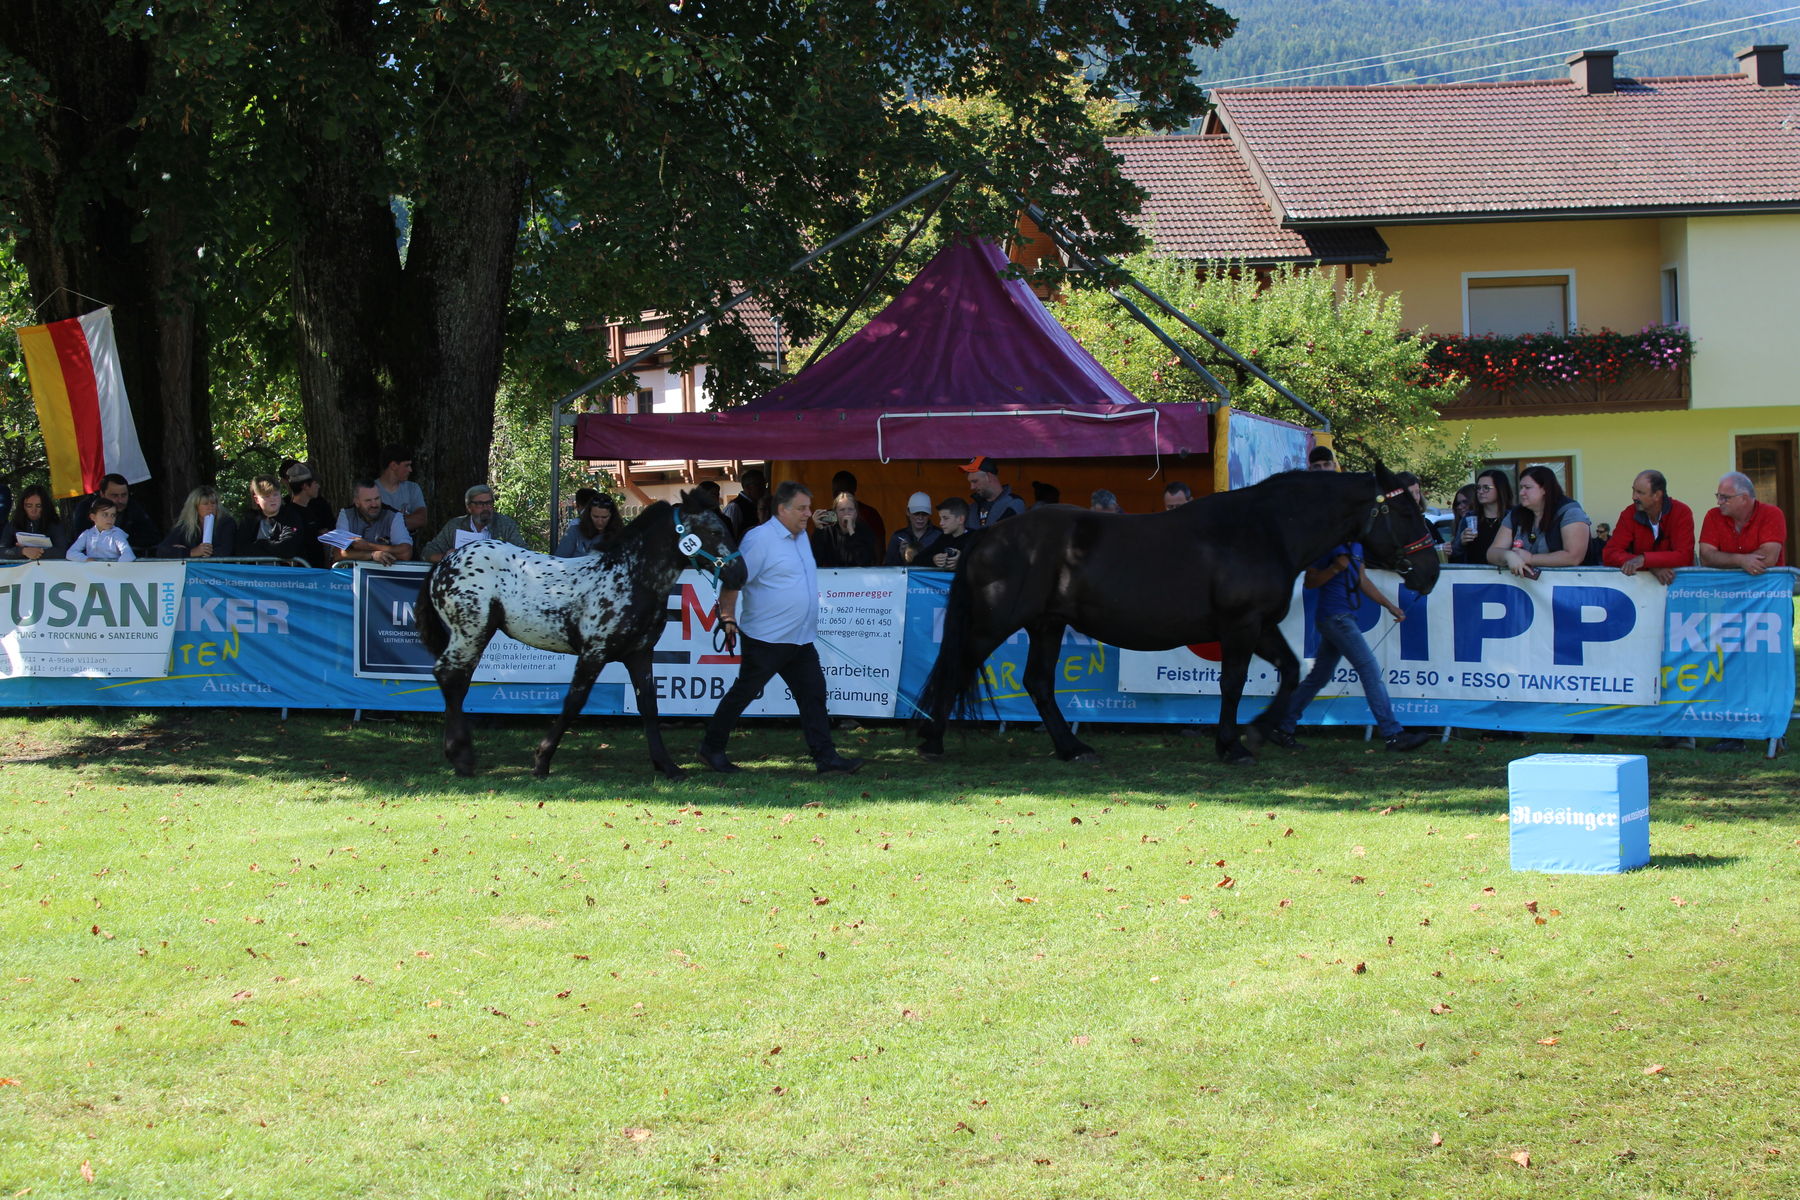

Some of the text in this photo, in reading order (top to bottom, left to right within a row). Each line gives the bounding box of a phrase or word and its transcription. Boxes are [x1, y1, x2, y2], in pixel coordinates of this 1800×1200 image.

[683, 537, 698, 552] 64
[186, 577, 318, 589] .pferde-kaerntenaustria.at
[826, 590, 893, 599] Sommeregger
[162, 582, 175, 627] GmbH
[837, 606, 854, 614] 9620
[855, 607, 892, 616] Hermagor
[829, 617, 847, 625] 0650
[855, 618, 865, 626] 60
[867, 618, 875, 626] 61
[878, 618, 892, 626] 450
[49, 631, 97, 640] TROCKNUNG
[108, 632, 159, 640] SANIERUNG
[817, 630, 891, 639] mmeregger@gmx.at
[503, 643, 519, 651] 676
[78, 656, 107, 664] Villach
[820, 663, 889, 678] erarbeiten
[202, 679, 272, 693] Austria
[1389, 671, 1410, 684] 25
[1416, 671, 1439, 685] 50
[1461, 672, 1510, 688] ESSO
[1518, 674, 1634, 693] TANKSTELLE
[492, 686, 560, 700] Austria
[1066, 694, 1137, 709] Austria
[1682, 705, 1762, 723] Austria
[1512, 805, 1618, 831] Rossinger
